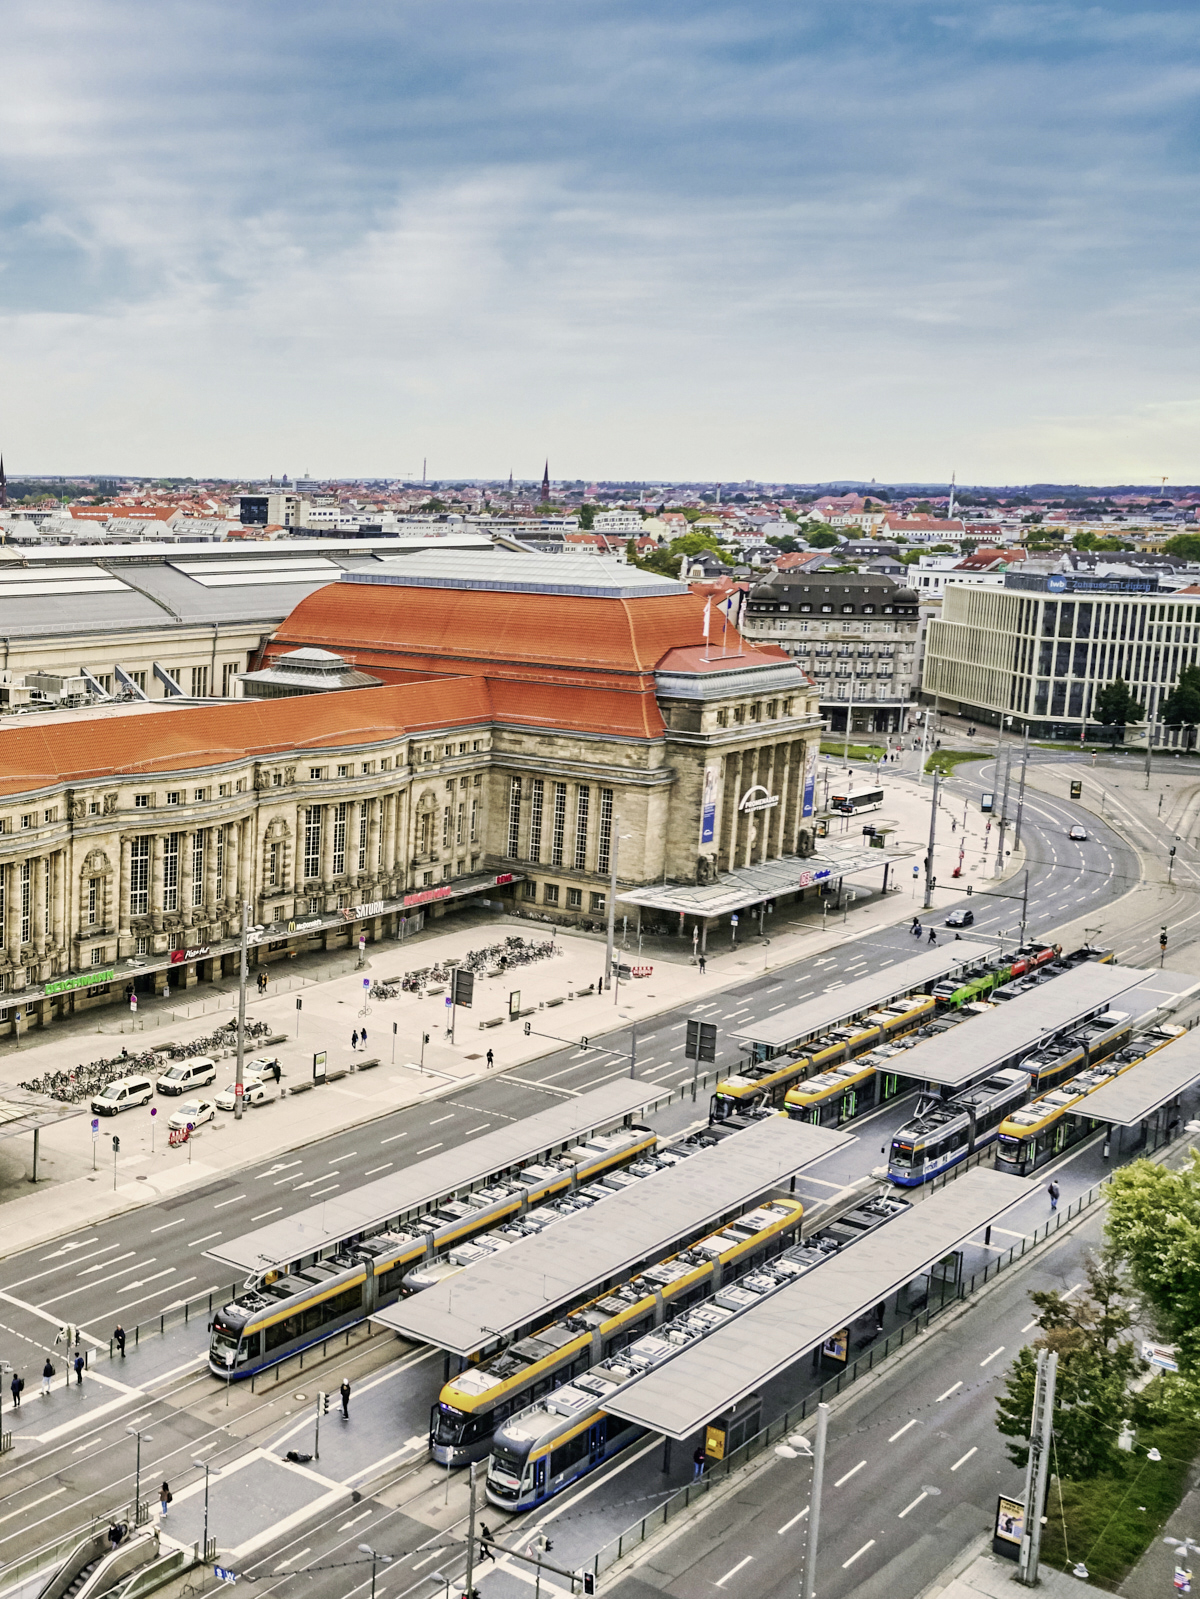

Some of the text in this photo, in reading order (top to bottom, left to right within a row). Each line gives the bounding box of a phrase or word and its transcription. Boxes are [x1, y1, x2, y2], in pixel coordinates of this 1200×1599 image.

[1072, 581, 1108, 589] Zuhause
[1120, 582, 1151, 592] Leipzig
[745, 795, 780, 808] PROMENADEN
[356, 900, 384, 918] SATURN
[185, 946, 210, 960] Pizza Hut
[45, 969, 114, 995] DEICHMANN
